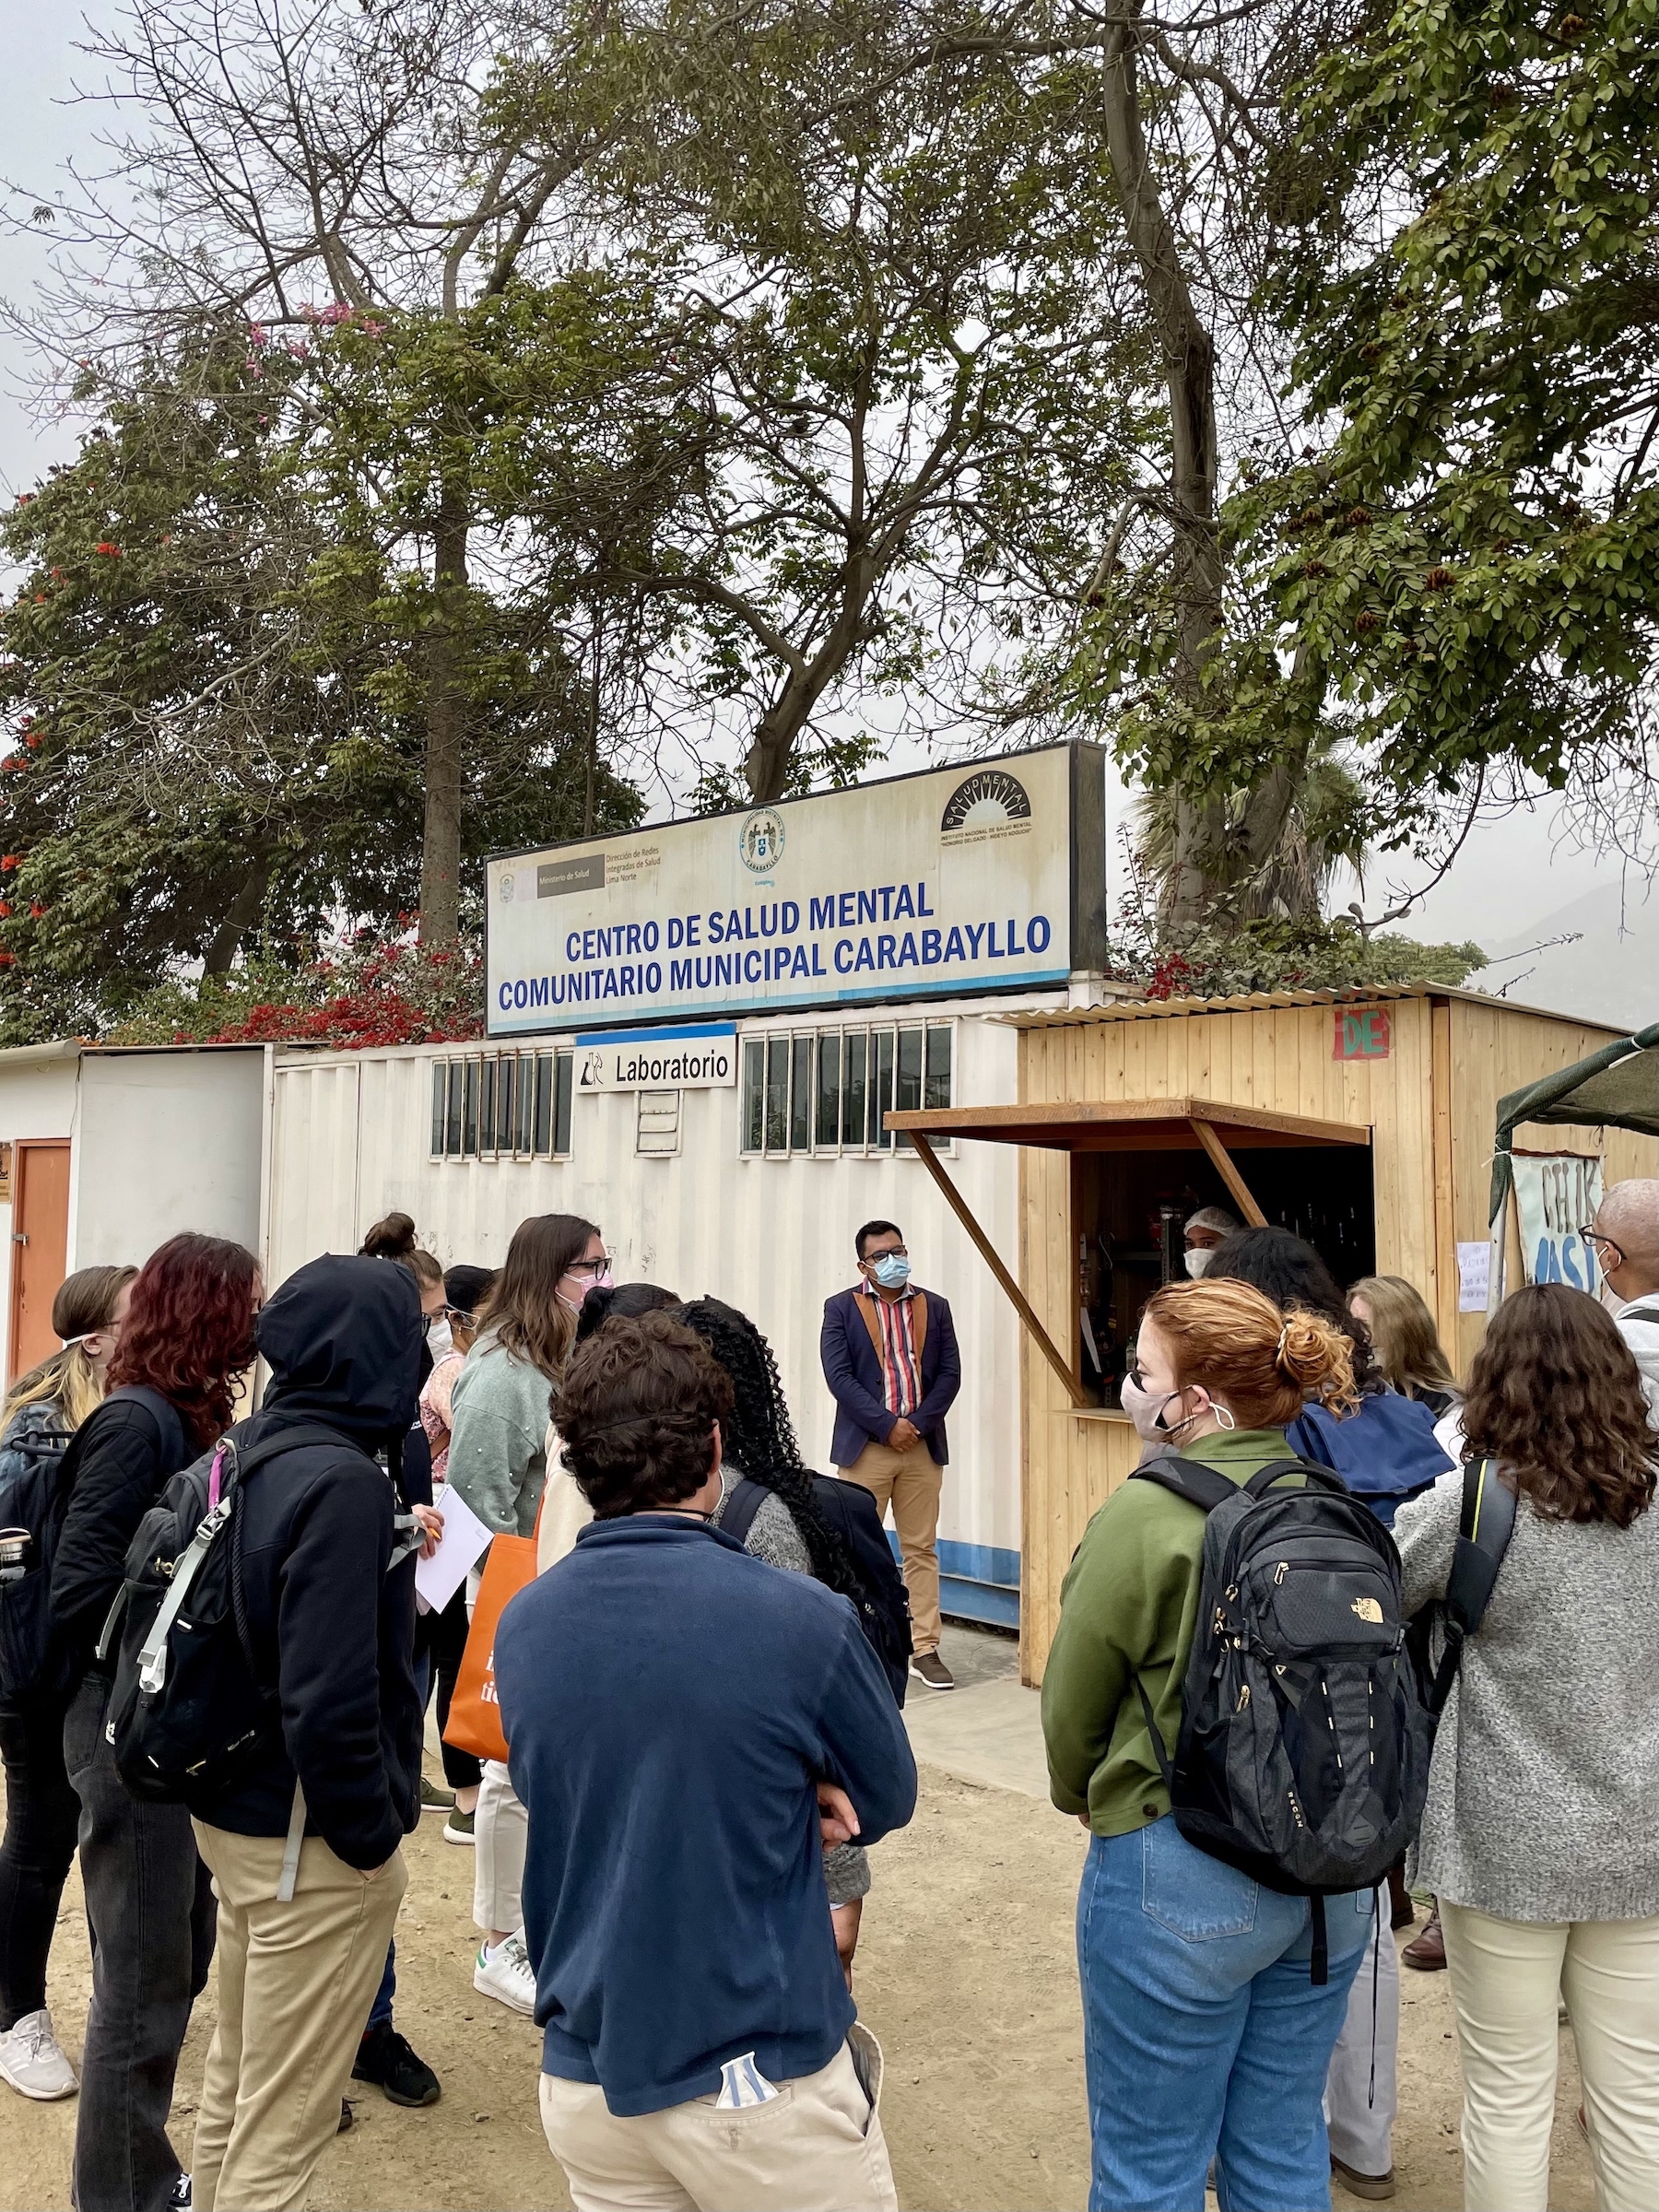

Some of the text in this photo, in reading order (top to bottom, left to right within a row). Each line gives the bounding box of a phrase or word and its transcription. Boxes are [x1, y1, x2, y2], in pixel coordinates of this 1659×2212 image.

[946, 774, 1027, 825] SALUD MENTAL
[964, 835, 986, 843] DELGADO
[990, 831, 1008, 840] HIDEYO
[965, 829, 988, 837] NACIONAL
[1013, 821, 1032, 830] MENTAL
[606, 847, 659, 863] Dirección de Redes
[747, 855, 778, 871] CARABAYLLO
[606, 857, 661, 875] Integradas de Salud
[539, 869, 590, 886] Ministerio de Salud
[606, 873, 637, 885] Lima Norte
[566, 882, 934, 962] CENTRO DE SALUD MENTAL
[499, 915, 1051, 1011] COMUNITARIO MUNICIPAL CARABAYLLO
[1343, 1010, 1384, 1056] DE
[616, 1049, 729, 1082] Laboratorio
